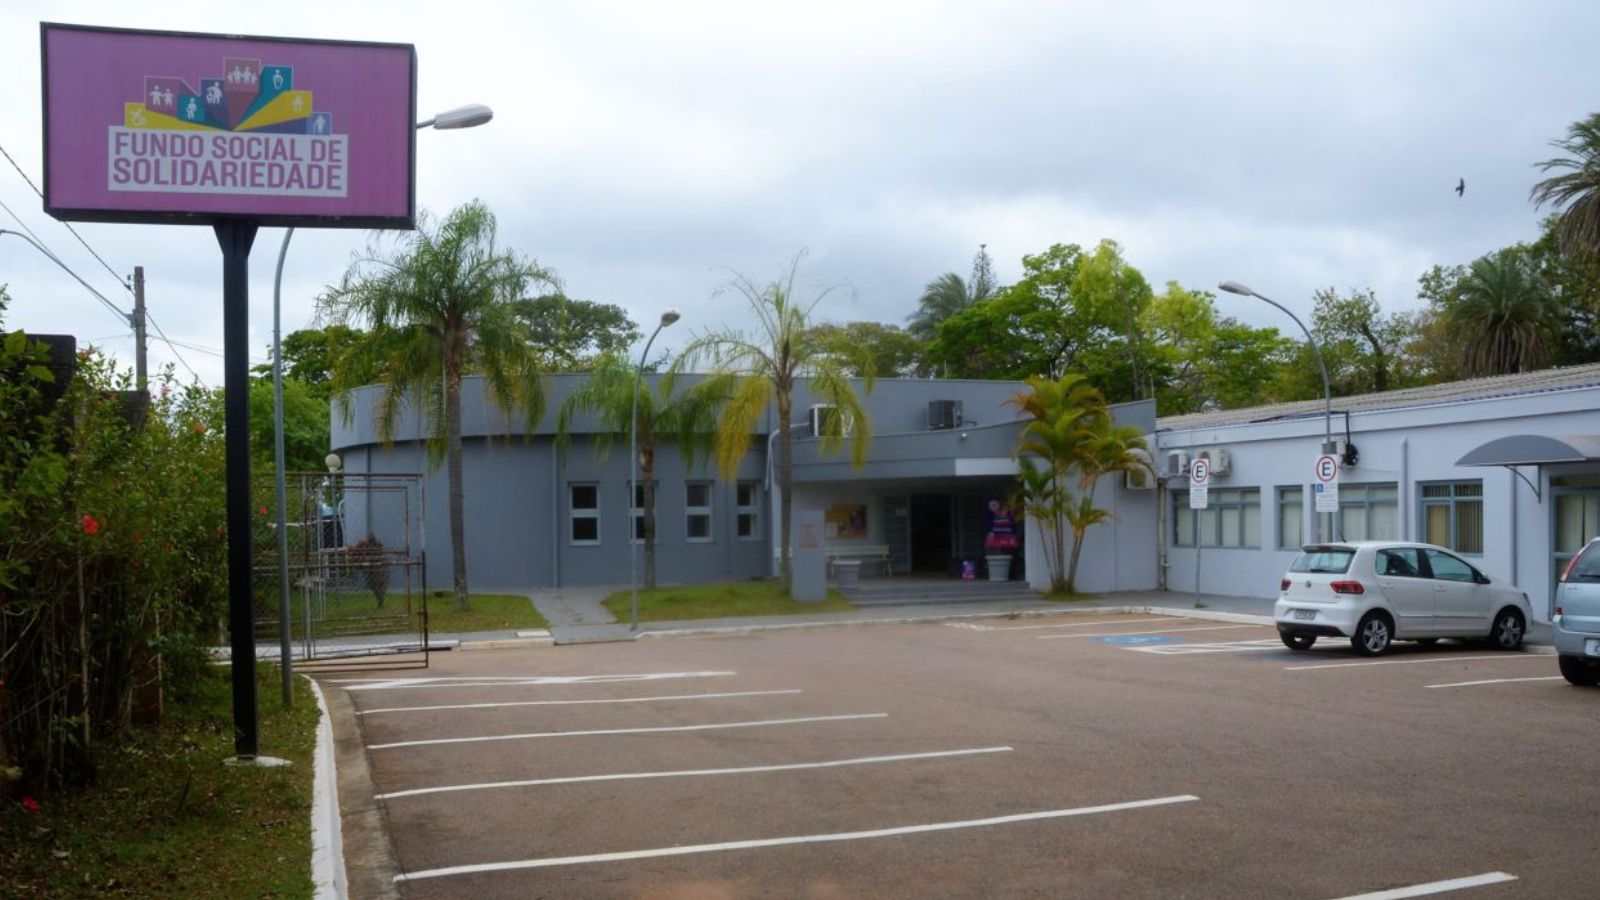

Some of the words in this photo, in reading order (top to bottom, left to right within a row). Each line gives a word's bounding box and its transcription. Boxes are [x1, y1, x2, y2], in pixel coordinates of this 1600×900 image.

[115, 132, 204, 158] FUNDO
[211, 135, 304, 161] SOCIAL
[311, 138, 342, 163] DE
[113, 158, 342, 190] SOLIDARIEDADE
[1196, 464, 1204, 479] E
[1321, 461, 1332, 477] E
